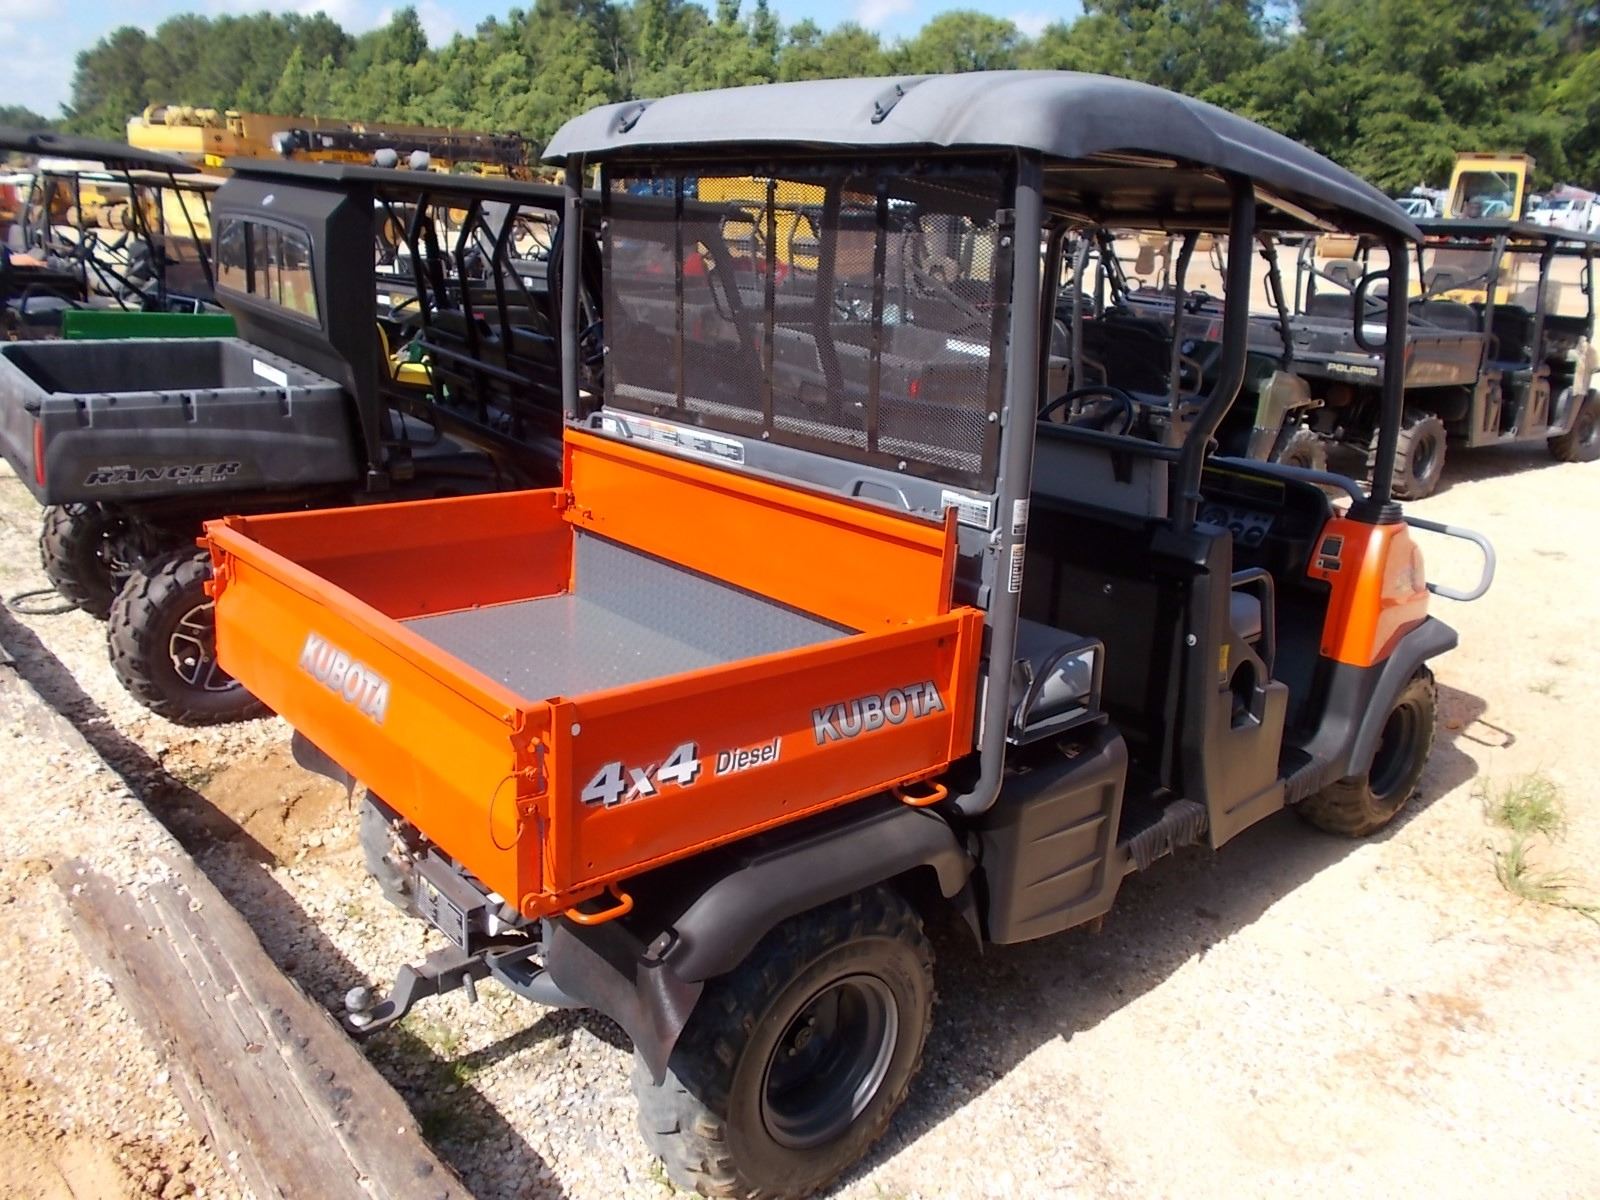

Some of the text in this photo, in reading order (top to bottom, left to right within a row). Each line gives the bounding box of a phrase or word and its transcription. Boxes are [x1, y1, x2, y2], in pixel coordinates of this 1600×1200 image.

[1327, 362, 1378, 376] POLARIS
[83, 462, 241, 486] RANGER
[299, 632, 389, 725] KUBOTA
[812, 680, 944, 745] KUBOTA
[581, 738, 782, 808] 4x4 Diesel
